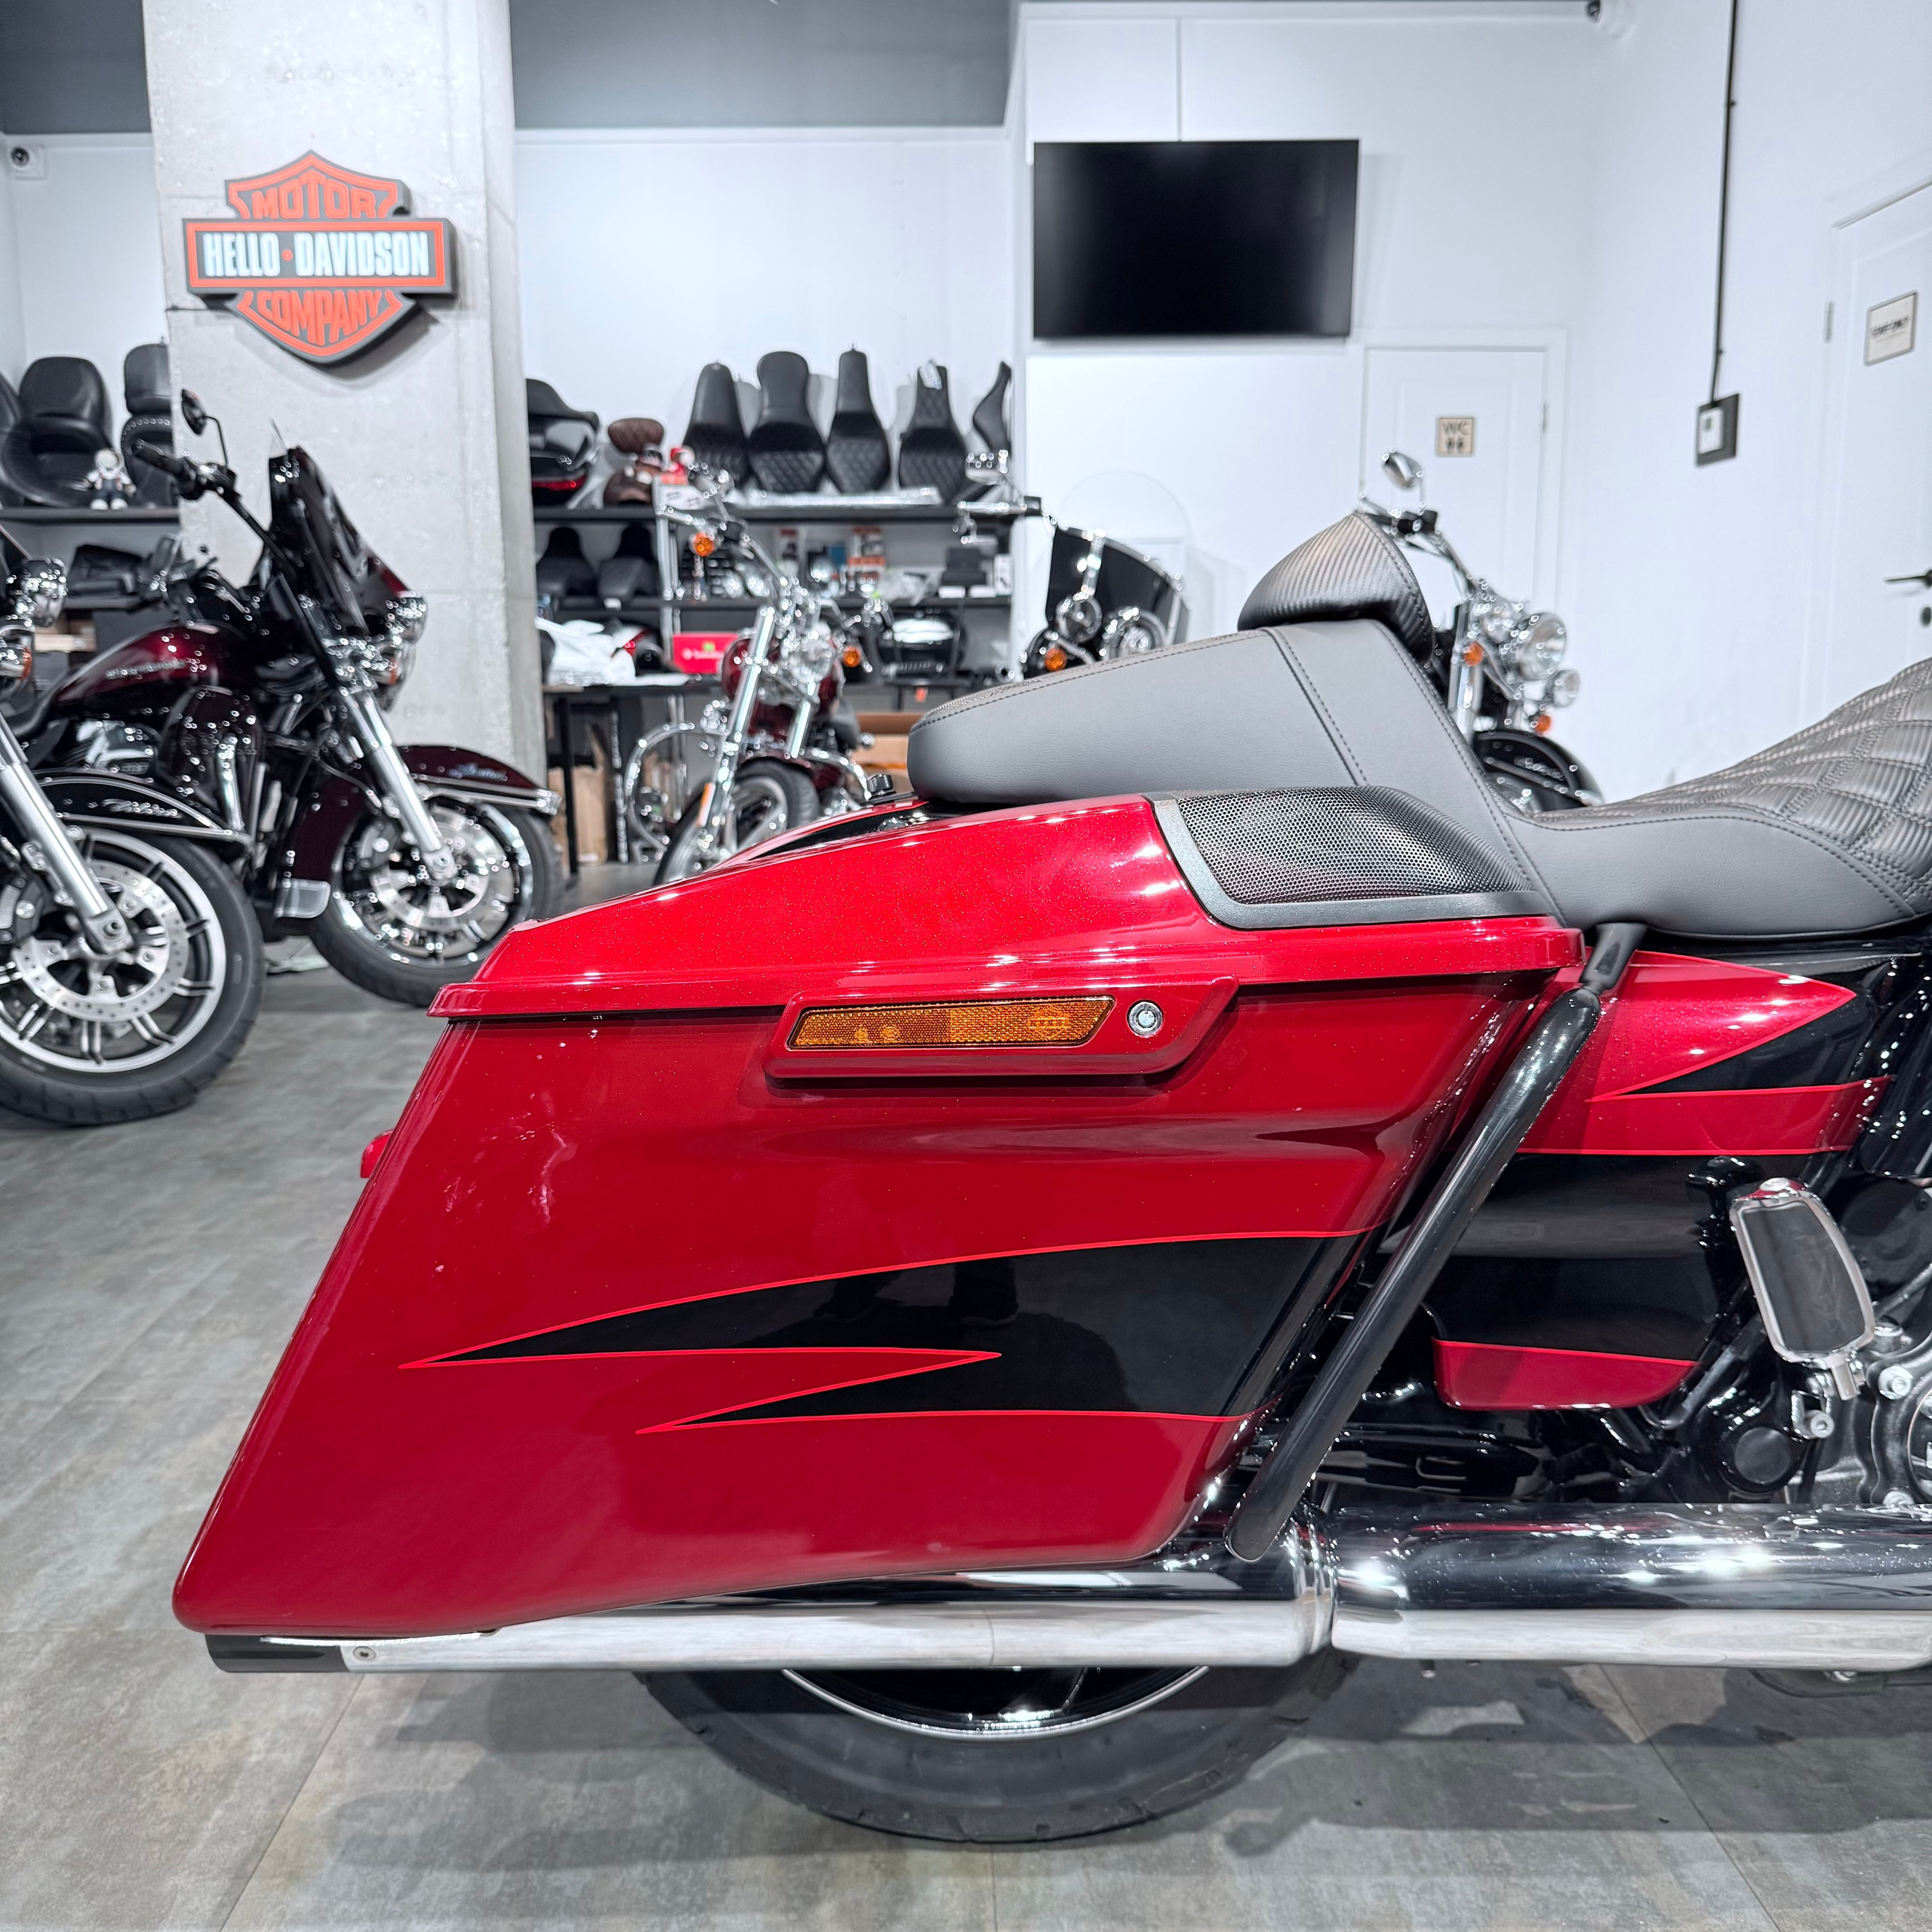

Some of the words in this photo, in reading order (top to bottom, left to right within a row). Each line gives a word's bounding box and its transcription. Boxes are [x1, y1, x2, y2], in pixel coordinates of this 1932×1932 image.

[251, 169, 376, 219] MOTOR
[203, 232, 281, 277] HELLO
[294, 231, 429, 276] DAVIDSON
[257, 290, 382, 346] COMPANY
[1442, 420, 1471, 435] WC
